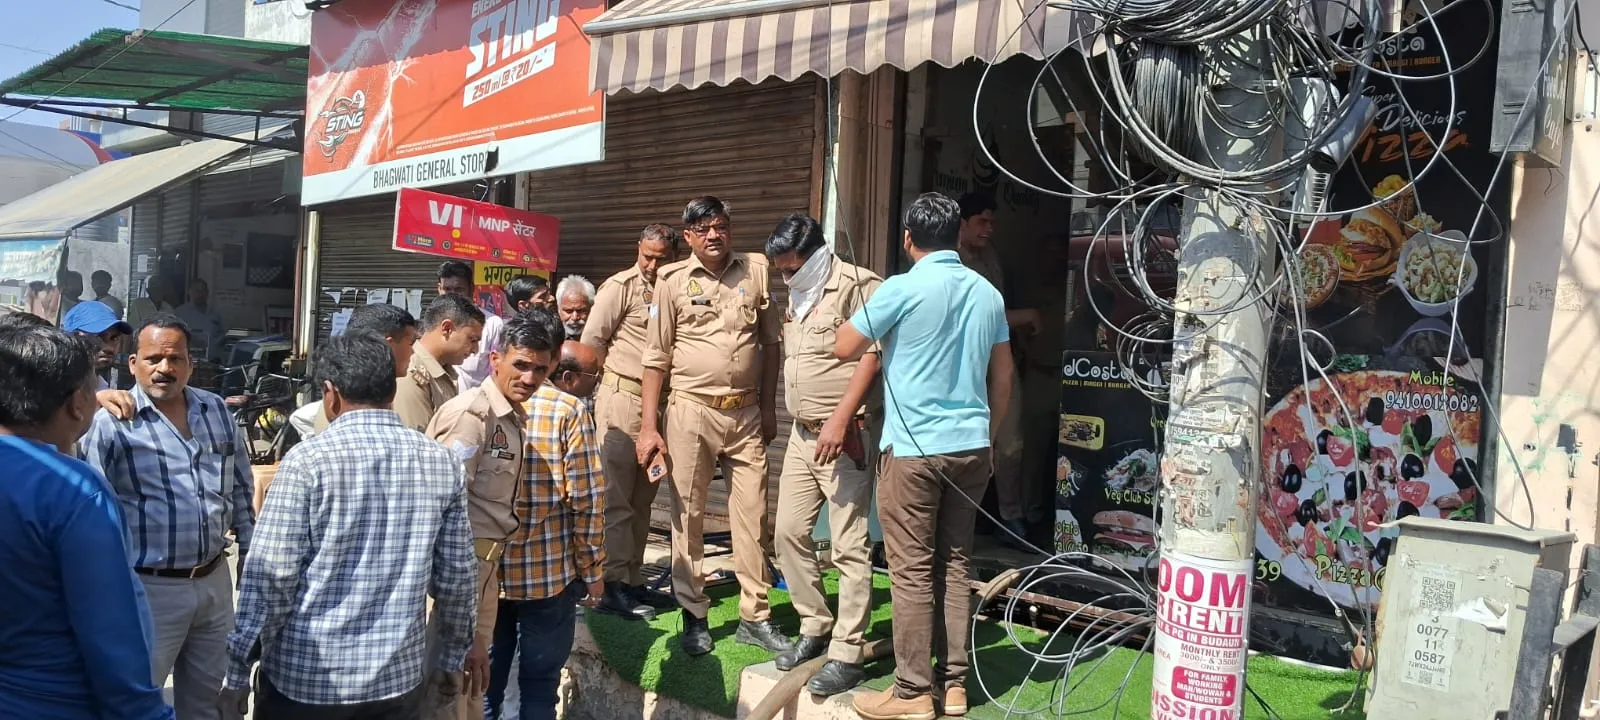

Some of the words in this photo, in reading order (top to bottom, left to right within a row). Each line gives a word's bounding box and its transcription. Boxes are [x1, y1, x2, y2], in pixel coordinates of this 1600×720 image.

[326, 111, 364, 133] STING
[1375, 103, 1467, 132] Delicious
[1361, 125, 1469, 162] izza
[373, 164, 414, 189] BHAGWATI
[416, 158, 457, 182] GENERAL
[460, 151, 488, 175] STOR
[478, 216, 511, 233] MNP
[512, 219, 537, 238] सेंटर
[1408, 369, 1455, 387] Mobile
[1104, 487, 1121, 505] Veg
[1123, 489, 1142, 504] Club
[1056, 519, 1080, 537] otato
[1159, 556, 1247, 608] OOM
[1171, 600, 1243, 634] RENT
[1171, 627, 1184, 640] PG
[1186, 630, 1198, 643] IN
[1201, 635, 1241, 647] BUDAUN
[1416, 623, 1449, 639] 0077
[1180, 643, 1221, 658] MONTHLY
[1424, 638, 1437, 650] 11
[1414, 650, 1446, 665] 0587
[1184, 669, 1199, 679] FOR
[1188, 678, 1223, 690] WORKING
[1152, 688, 1236, 720] ISSION
[1184, 691, 1223, 705] STUDENTS
